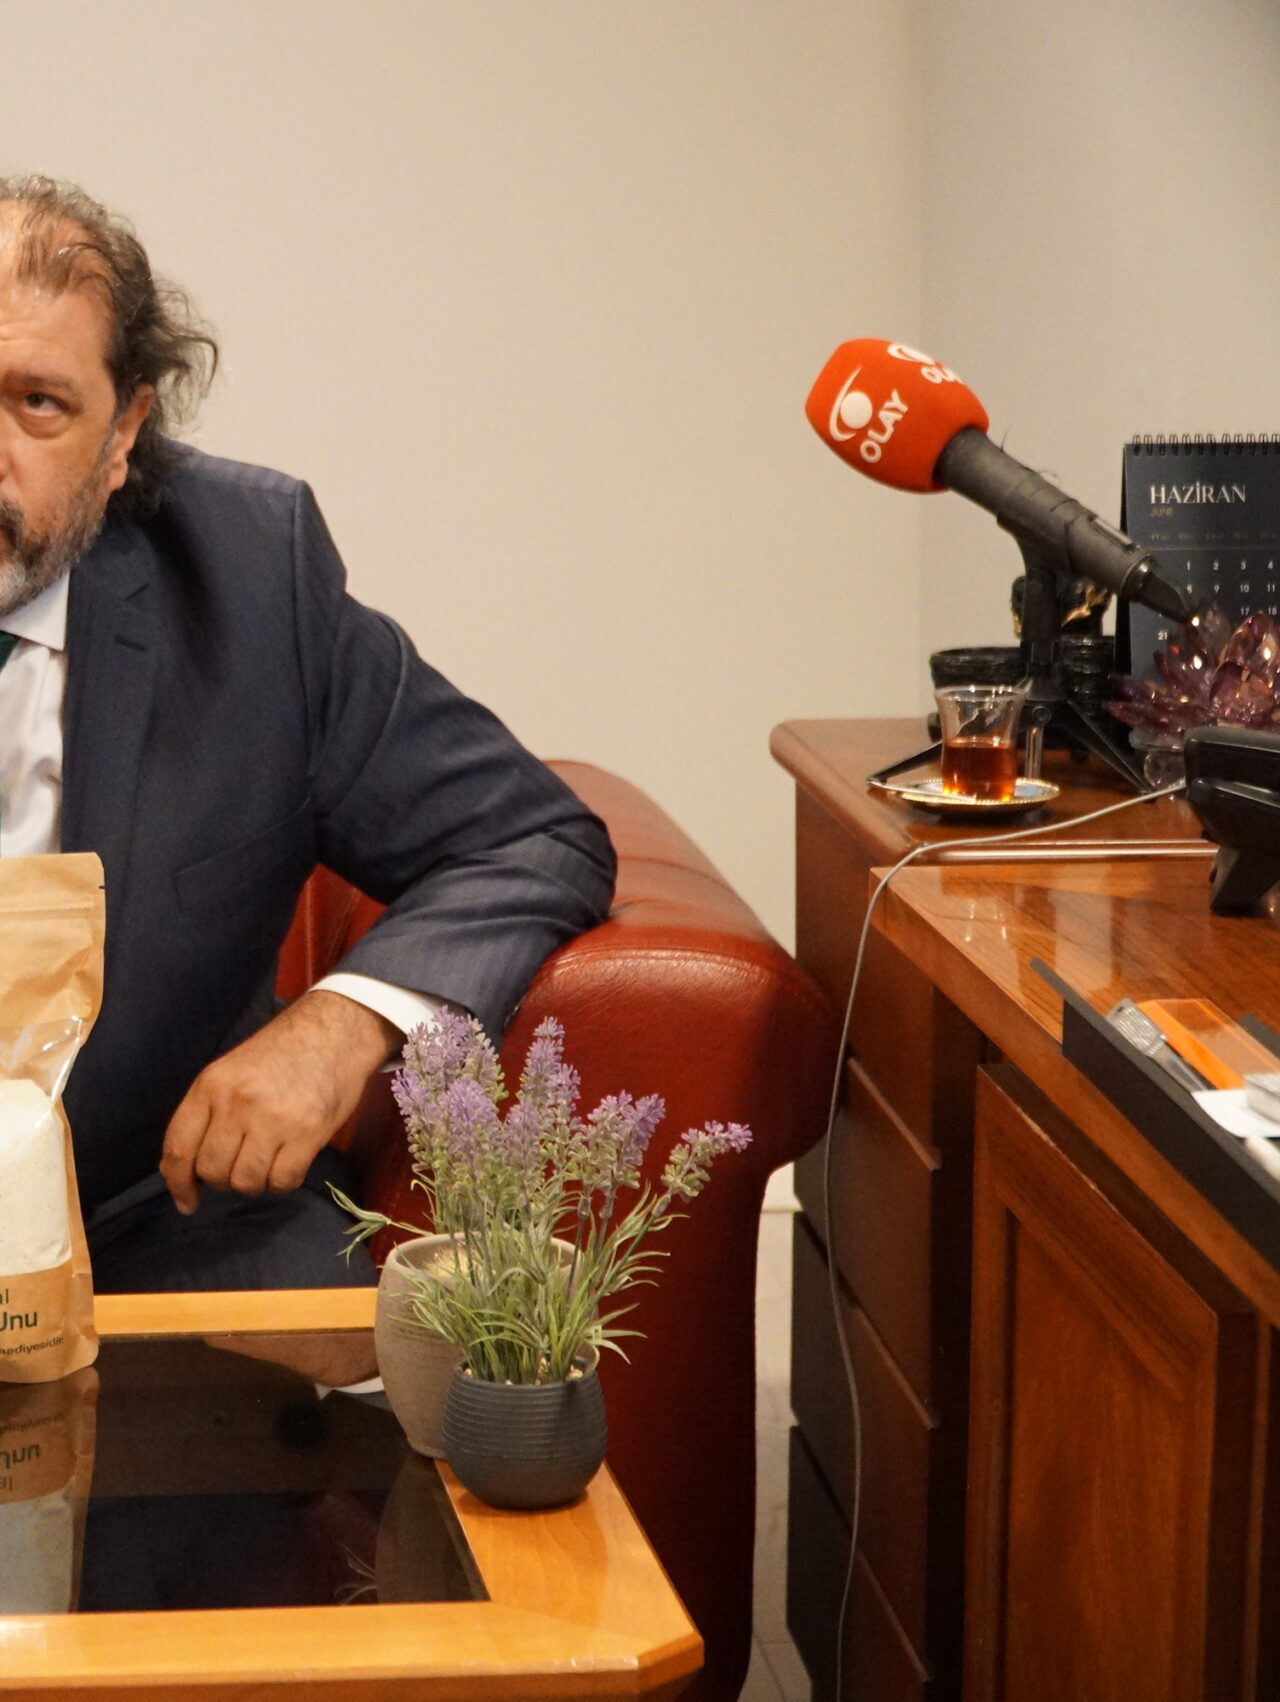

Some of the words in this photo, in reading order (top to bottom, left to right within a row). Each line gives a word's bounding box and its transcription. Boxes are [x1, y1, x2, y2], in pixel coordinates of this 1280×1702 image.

[859, 389, 909, 463] OLAY
[1149, 481, 1246, 504] HAZİRAN
[1150, 507, 1174, 517] JUNE
[1213, 561, 1219, 571] 2
[1240, 561, 1246, 570] 3
[1267, 561, 1273, 570] 4
[1214, 584, 1220, 593] 9
[1240, 584, 1250, 593] 10
[1266, 584, 1276, 593] 11
[1240, 607, 1250, 616] 17
[1267, 607, 1277, 616] 18
[1158, 631, 1168, 641] 21
